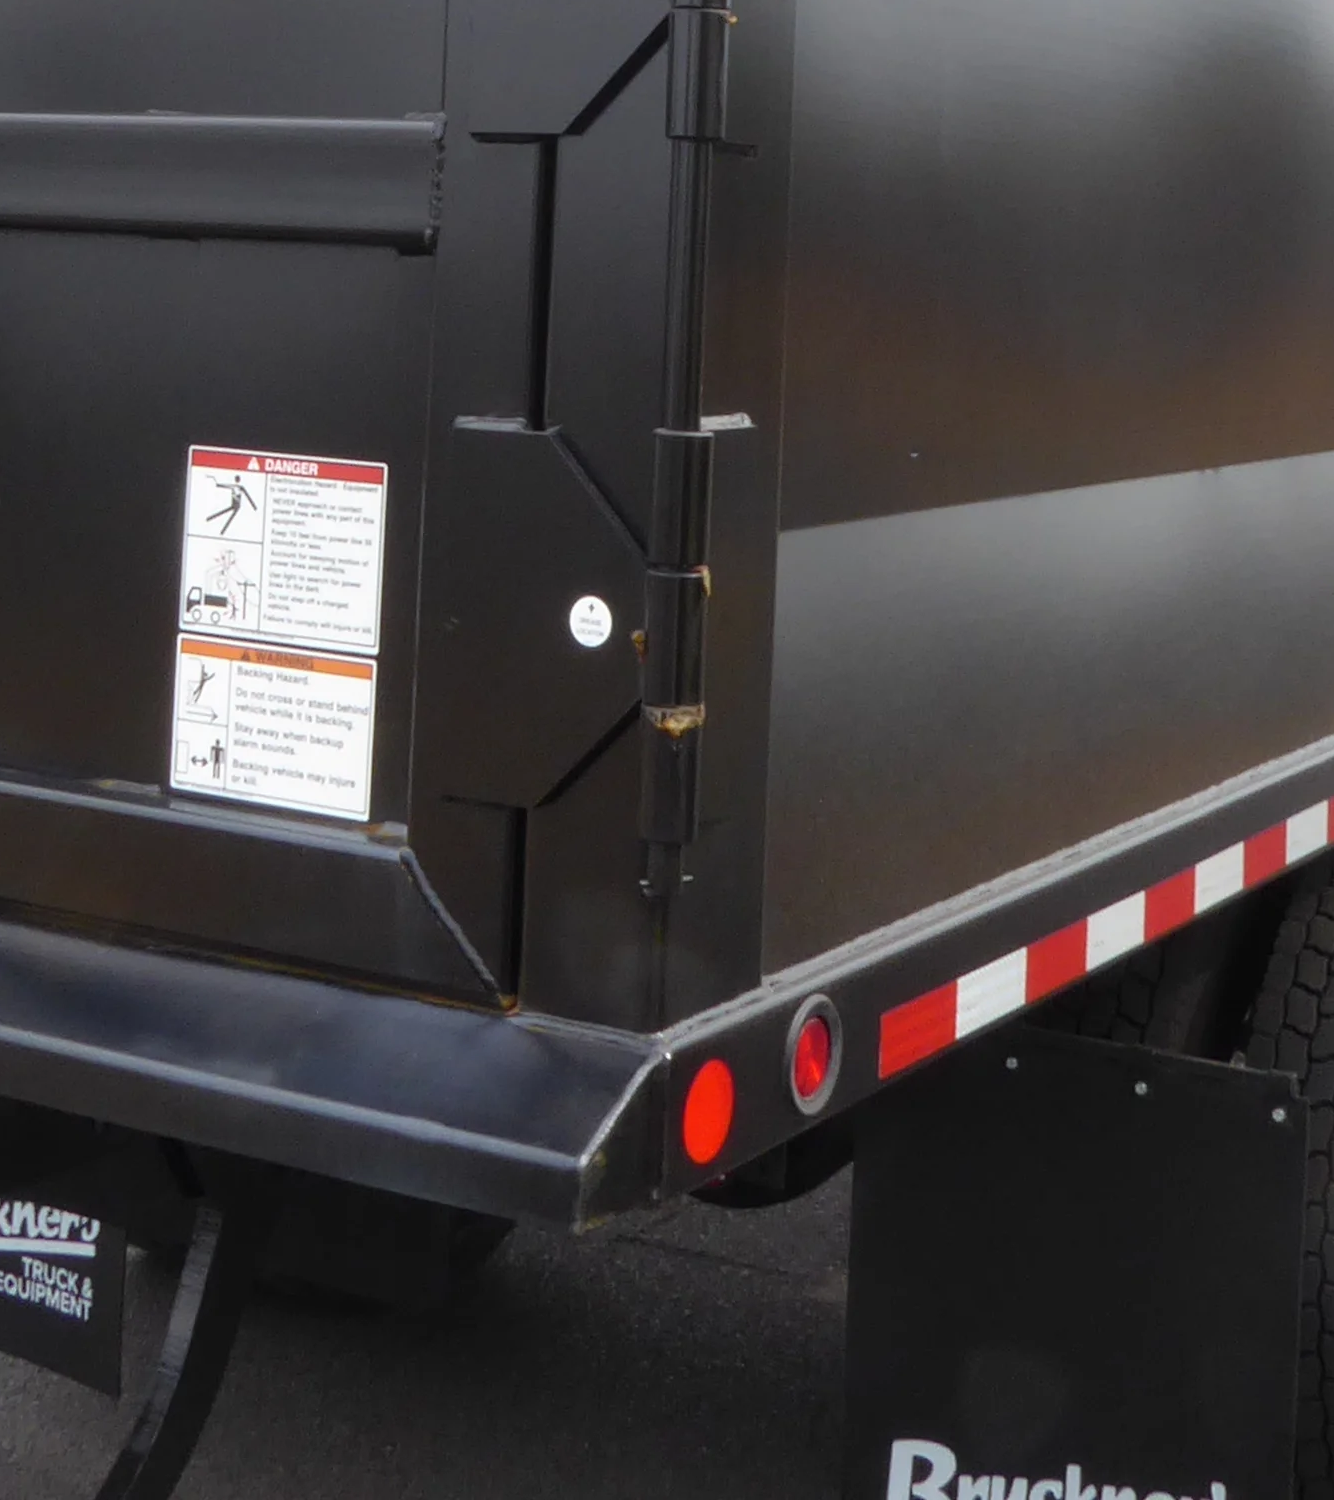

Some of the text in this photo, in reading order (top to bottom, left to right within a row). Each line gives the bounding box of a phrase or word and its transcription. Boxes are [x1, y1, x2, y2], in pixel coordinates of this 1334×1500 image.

[264, 458, 319, 476] DANGER
[255, 650, 315, 670] WARNING
[236, 665, 273, 683] Backing
[234, 701, 266, 715] vehicle
[269, 706, 293, 720] while
[296, 711, 302, 720] it
[304, 712, 312, 722] is
[235, 686, 368, 716] Do not cross or stand behind
[233, 737, 258, 749] alarm
[234, 721, 344, 750] Stay away when backup
[232, 757, 356, 791] Backing vehicle may injure
[22, 1257, 93, 1299] TRUCK &
